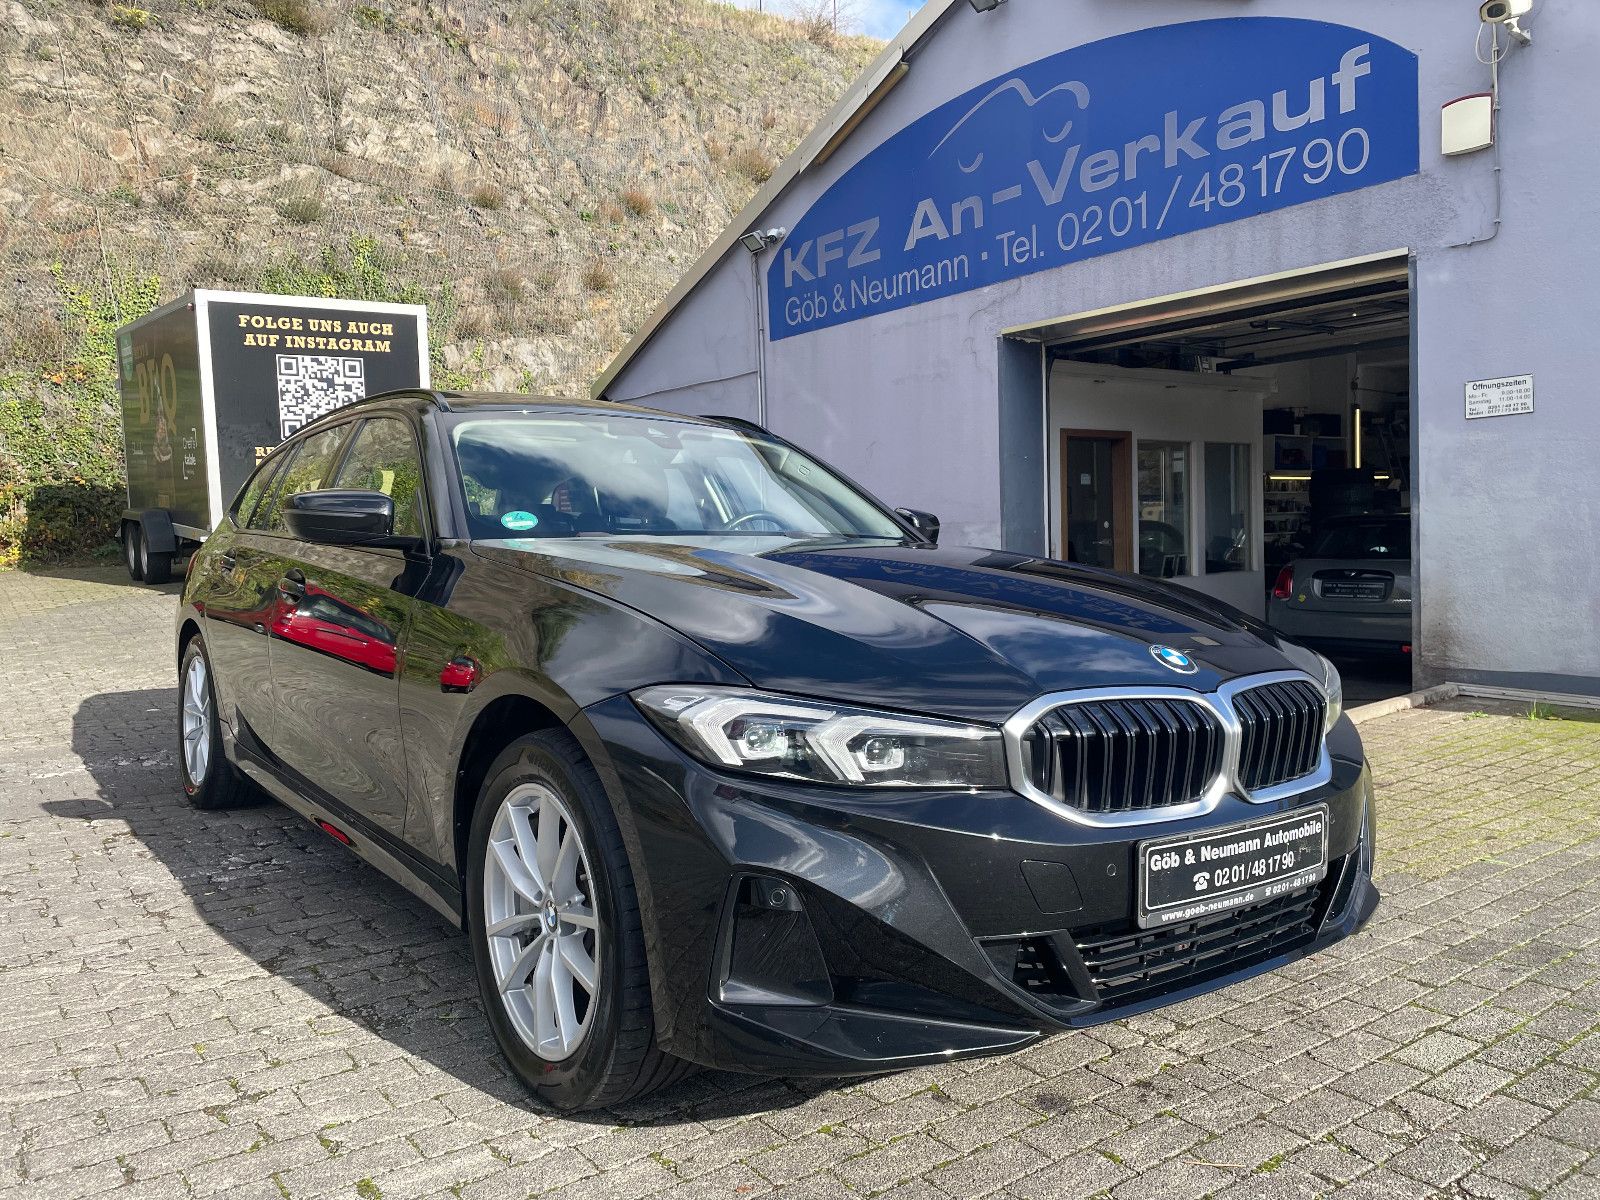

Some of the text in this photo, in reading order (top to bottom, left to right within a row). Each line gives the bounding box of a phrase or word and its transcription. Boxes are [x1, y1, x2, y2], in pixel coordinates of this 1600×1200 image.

[784, 43, 1371, 288] KFZ An-Verkauf
[785, 294, 828, 326] Göb
[833, 284, 847, 312] &
[850, 254, 970, 308] Neumann
[995, 230, 1047, 268] Tel.
[238, 314, 394, 336] FOLGE UNS AUCH
[243, 333, 391, 353] AUF INSTAGRAM
[1472, 379, 1527, 391] Öffnungszeiten
[1151, 819, 1322, 872] Göb & Neumann Automobile
[1161, 892, 1254, 922] www.goeb-neumann.de
